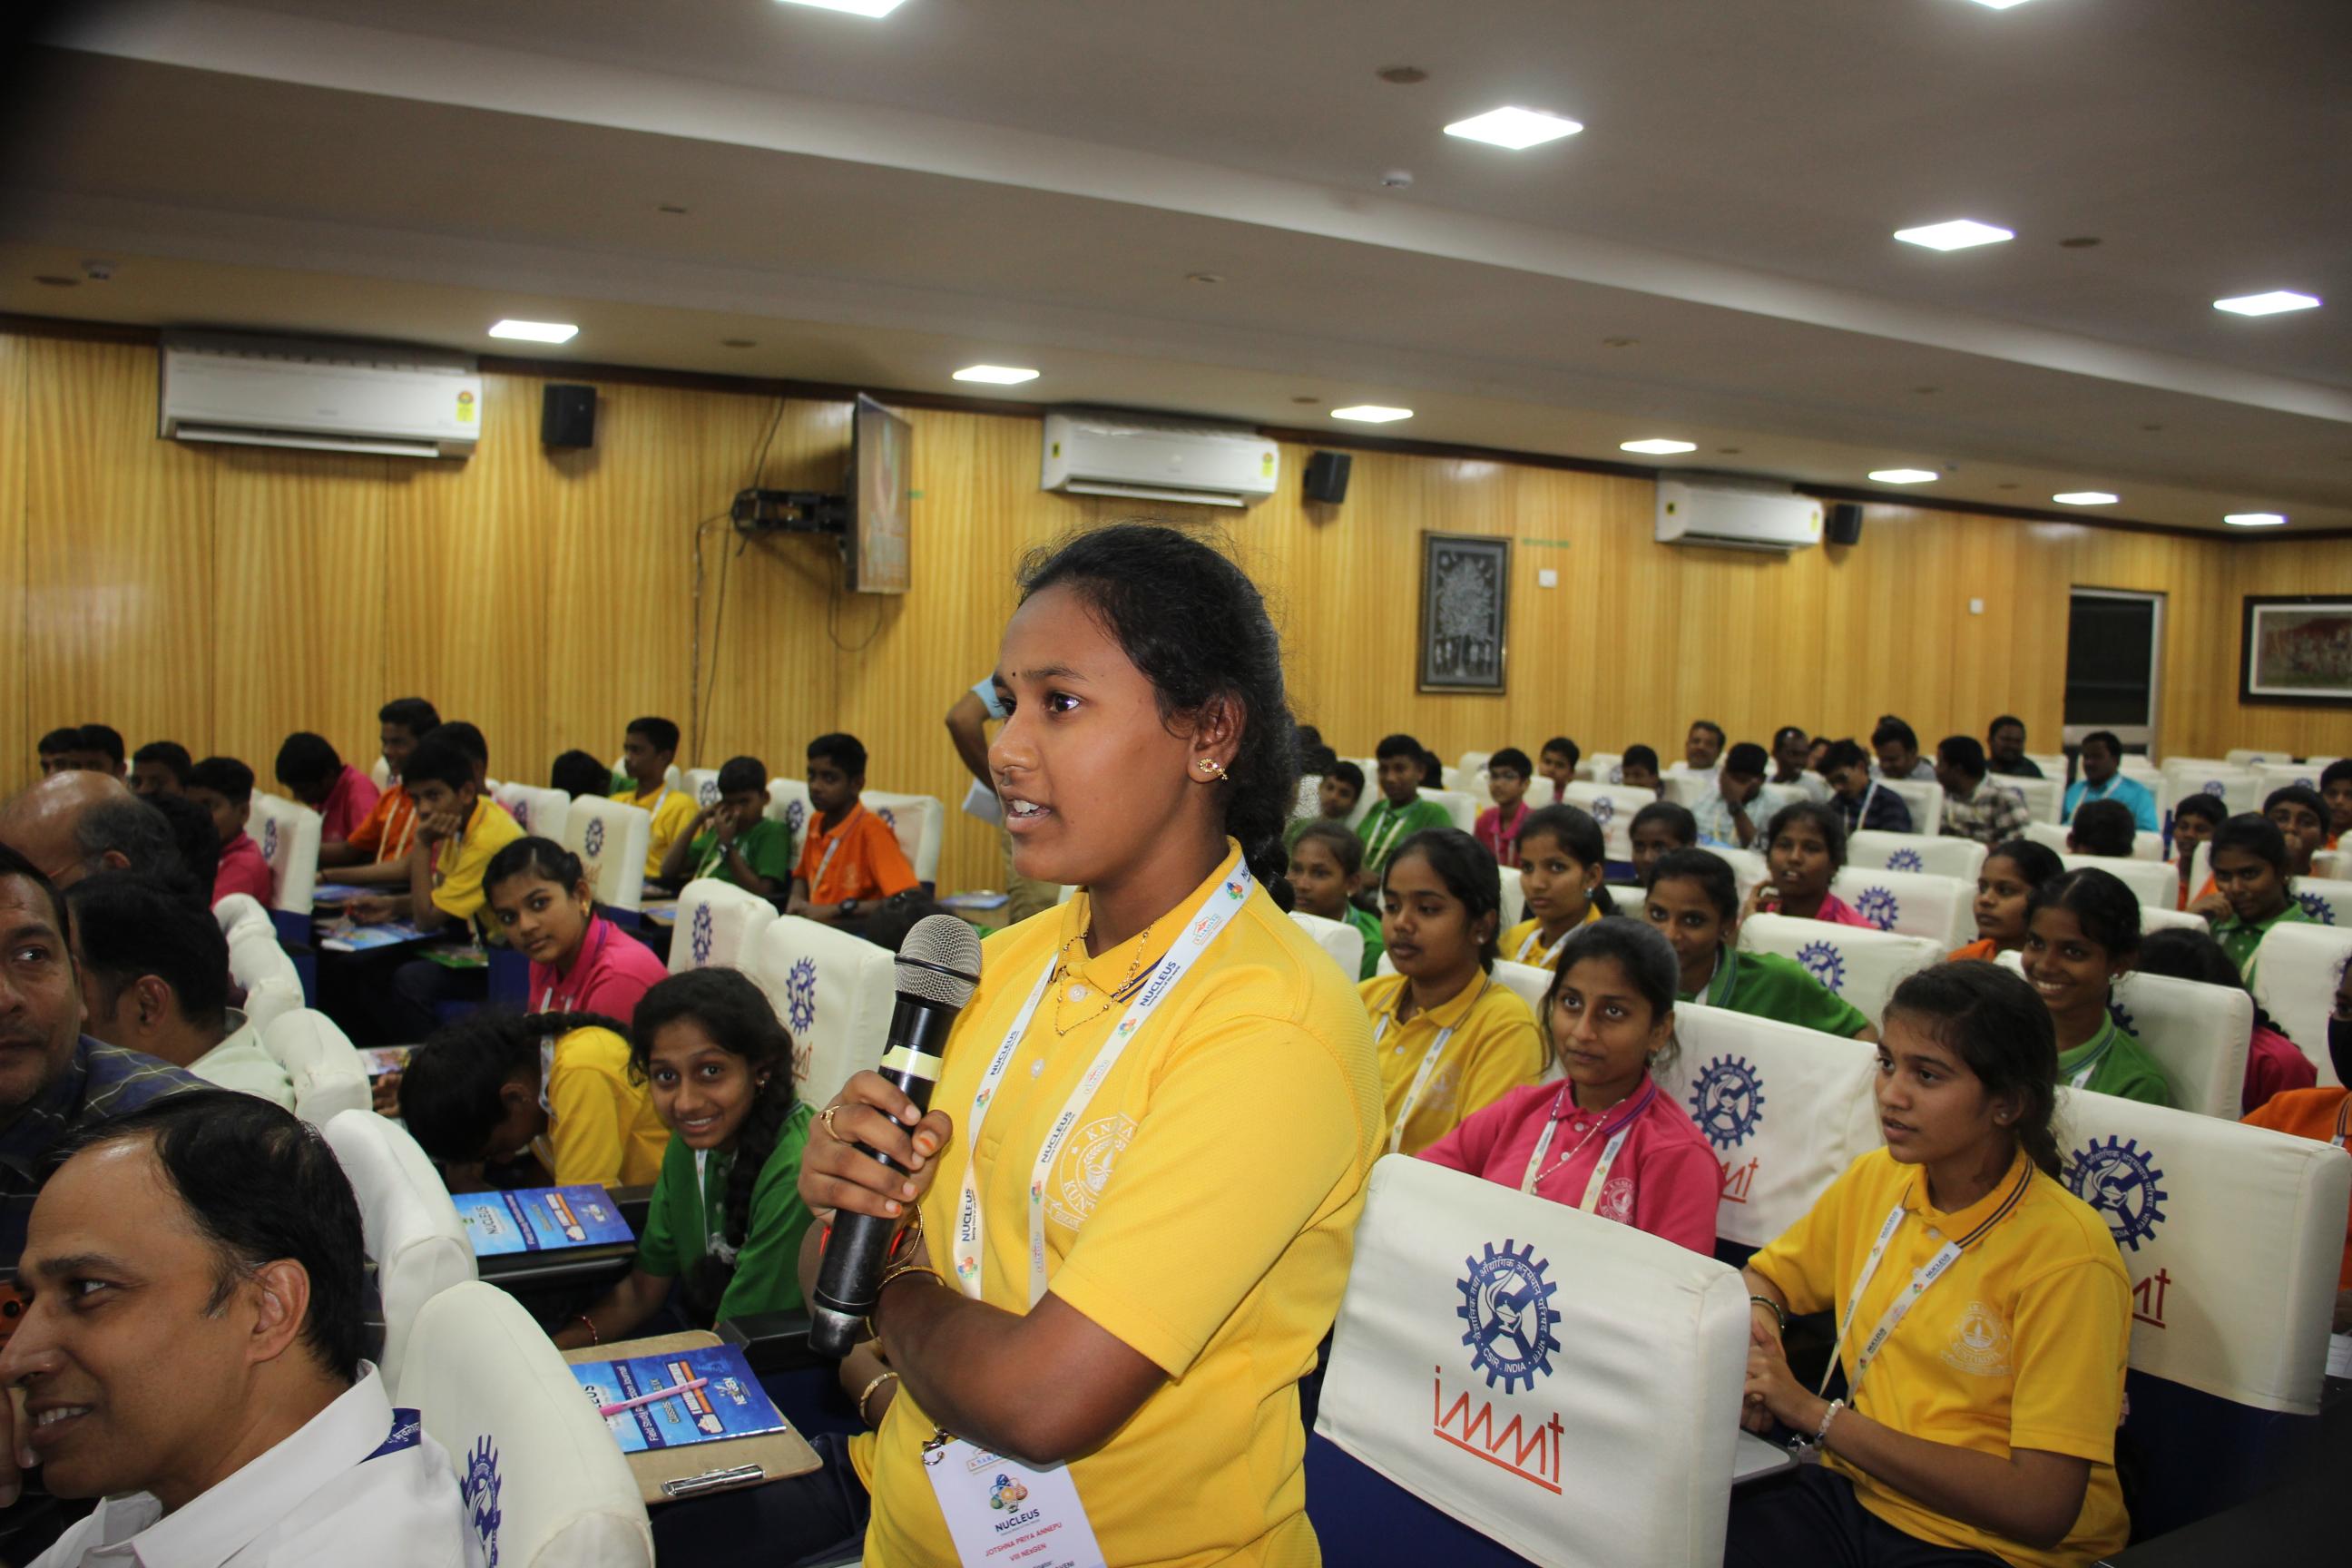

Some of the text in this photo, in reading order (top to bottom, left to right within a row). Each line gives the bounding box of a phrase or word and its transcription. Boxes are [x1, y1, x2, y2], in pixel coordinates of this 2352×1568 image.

[1140, 961, 1177, 1006] NUCLEUS
[990, 1031, 1017, 1075] NUCLEUS
[1041, 1112, 1073, 1163] NUCLEUS
[475, 1206, 499, 1235] NUCLEUS
[962, 1188, 973, 1242] NUCLEUS
[1926, 1253, 1951, 1279] NUCLEUS
[1867, 1328, 1886, 1353] NUCLEUS
[1483, 1348, 1527, 1373] CSIR INDIA
[615, 1365, 633, 1386] Journal
[637, 1411, 652, 1427] Study
[644, 1427, 659, 1441] Field
[995, 1509, 1040, 1533] NUCLEUS
[985, 1541, 1015, 1557] JOTSHNA
[1015, 1534, 1035, 1544] PRIYA
[1036, 1522, 1062, 1536] ANNEPU
